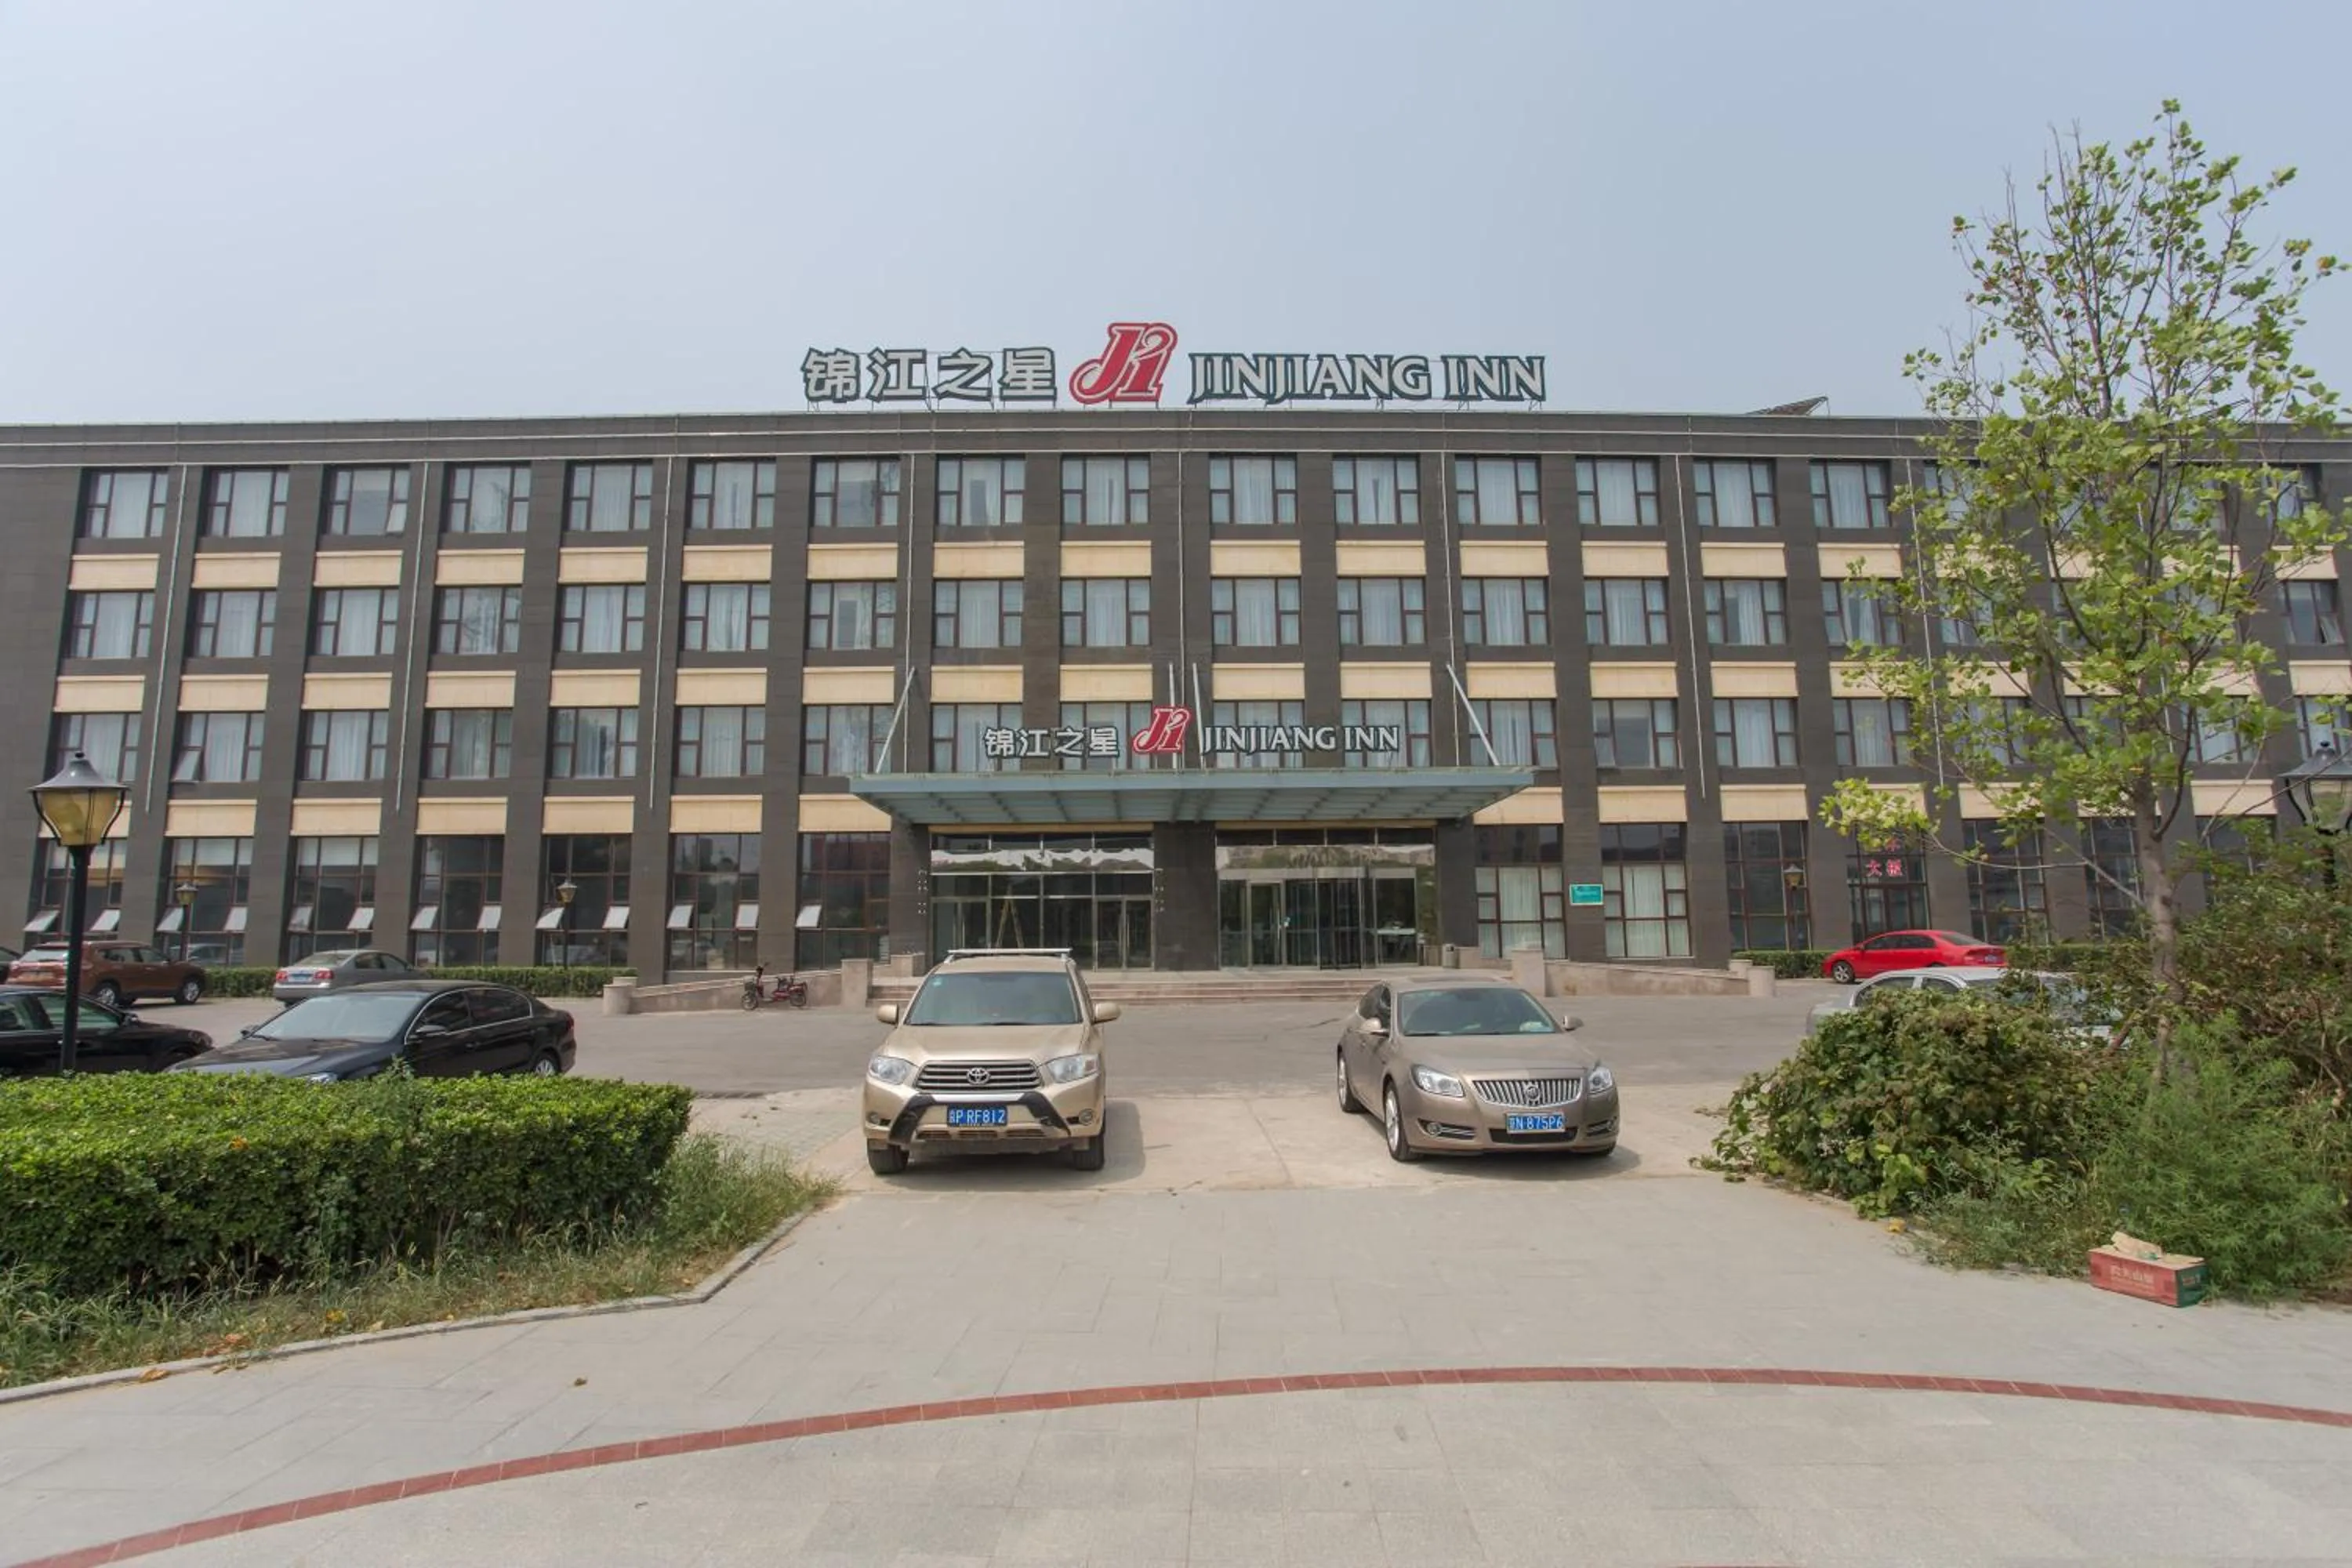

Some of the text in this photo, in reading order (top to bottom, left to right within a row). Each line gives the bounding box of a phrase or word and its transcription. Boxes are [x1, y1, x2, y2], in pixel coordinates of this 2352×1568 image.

[800, 347, 1057, 403] 锦江之星
[1187, 353, 1545, 405] JINJIANG INN
[983, 726, 1120, 758] 锦江之星
[1203, 725, 1399, 755] JINJIANG INN
